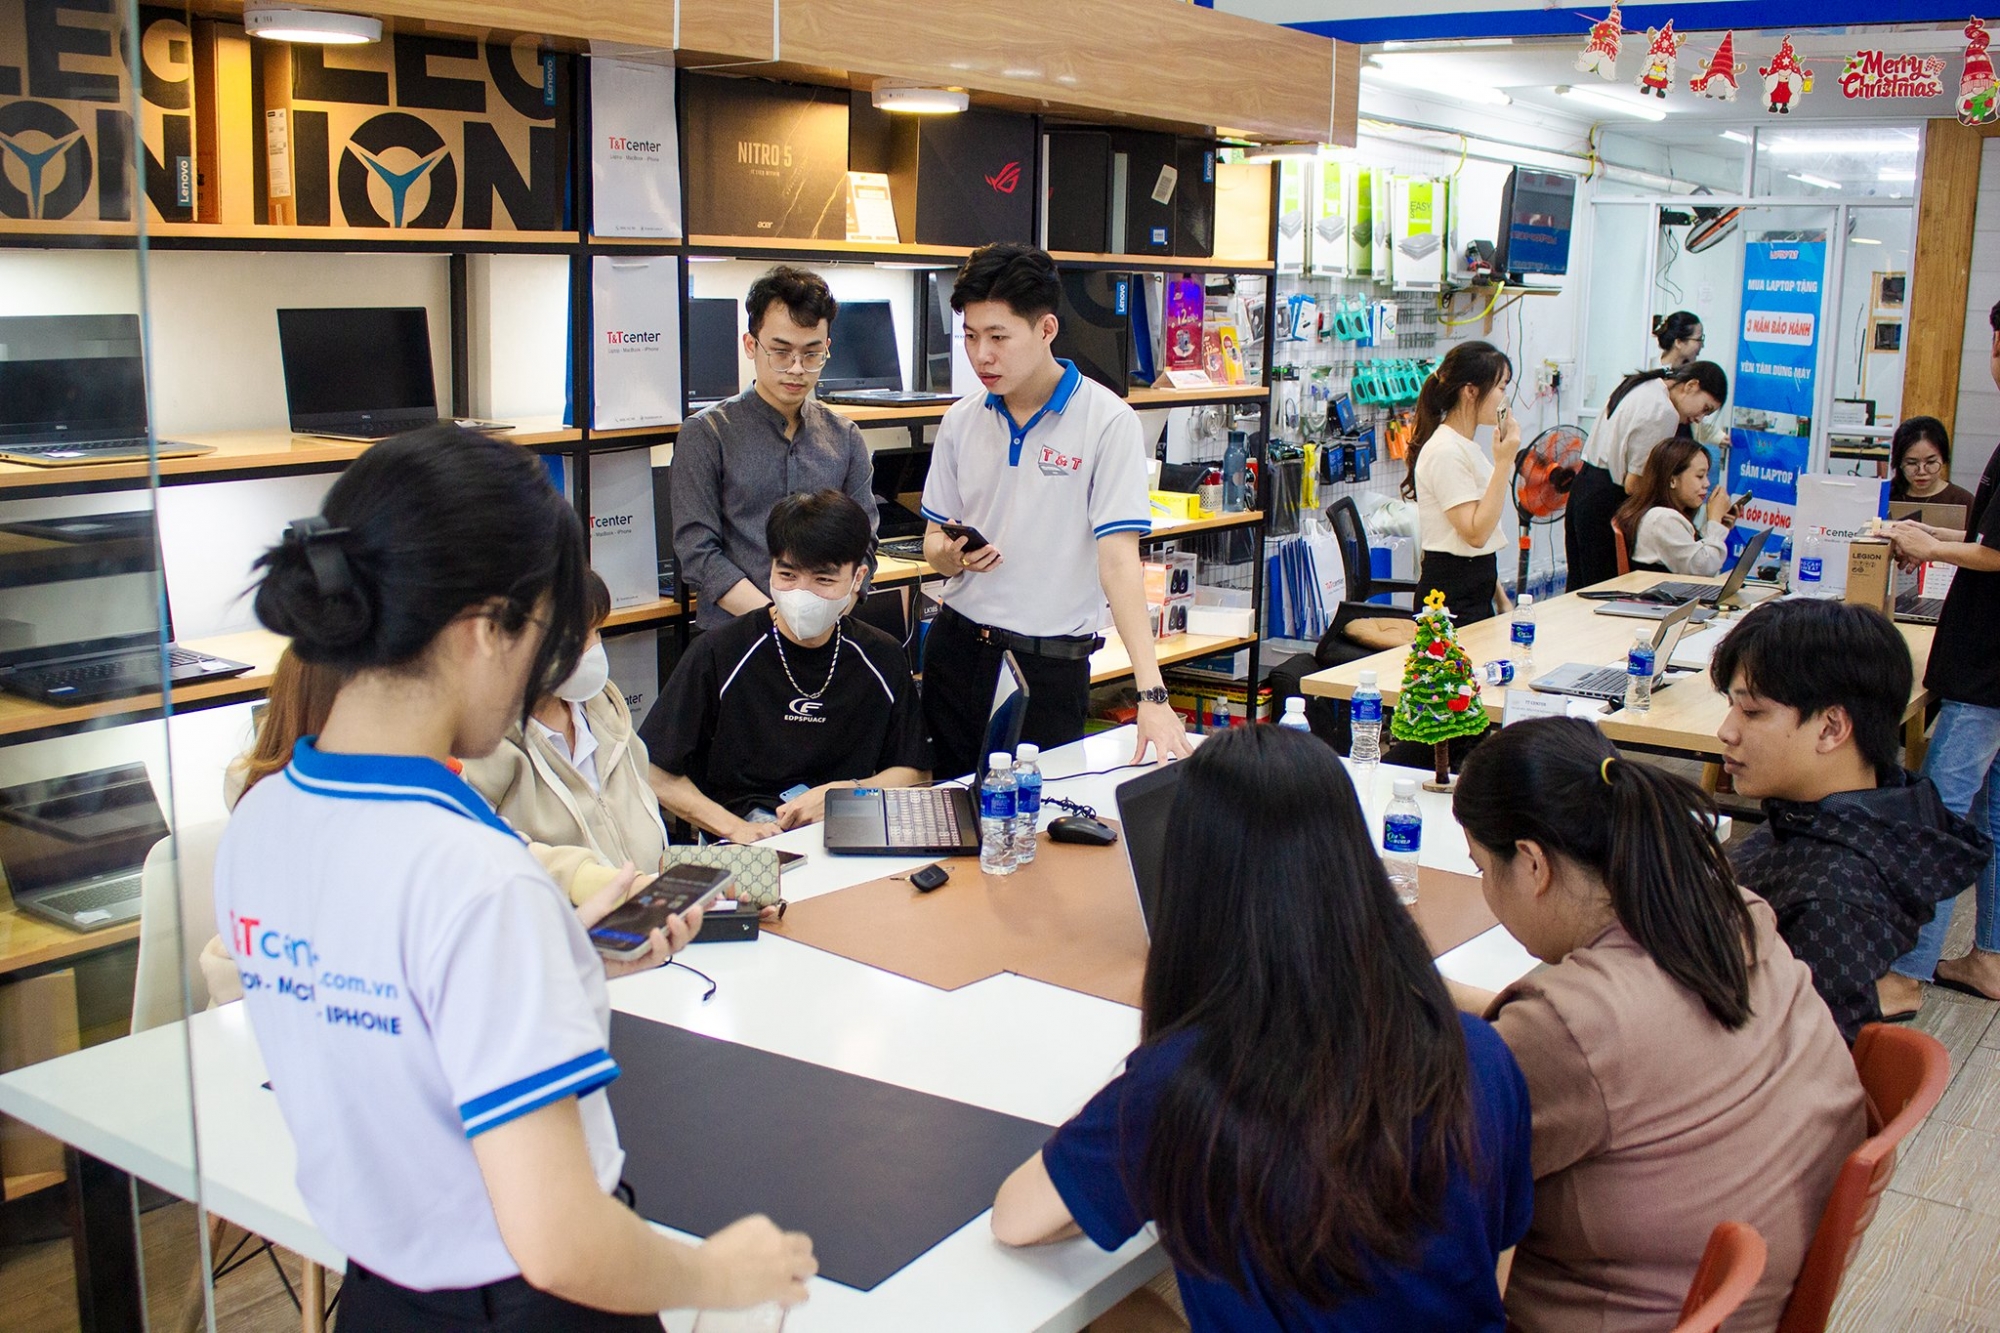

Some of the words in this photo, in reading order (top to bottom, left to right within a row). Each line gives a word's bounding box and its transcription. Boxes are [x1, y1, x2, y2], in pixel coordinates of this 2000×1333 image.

[1856, 50, 1931, 81] Merry
[1838, 72, 1942, 98] Christmas
[738, 141, 780, 166] NITRO
[783, 145, 792, 167] 5
[180, 160, 189, 203] Lenovo
[757, 221, 773, 229] acer
[1748, 279, 1765, 291] MUA
[1766, 279, 1795, 292] LAPTOP
[1118, 284, 1126, 312] Lenovo
[1746, 319, 1752, 332] 3
[607, 331, 661, 344] T&Tcenter
[1761, 467, 1793, 484] LAPTOP
[590, 515, 633, 528] Tcenter
[1746, 504, 1762, 522] GÓP
